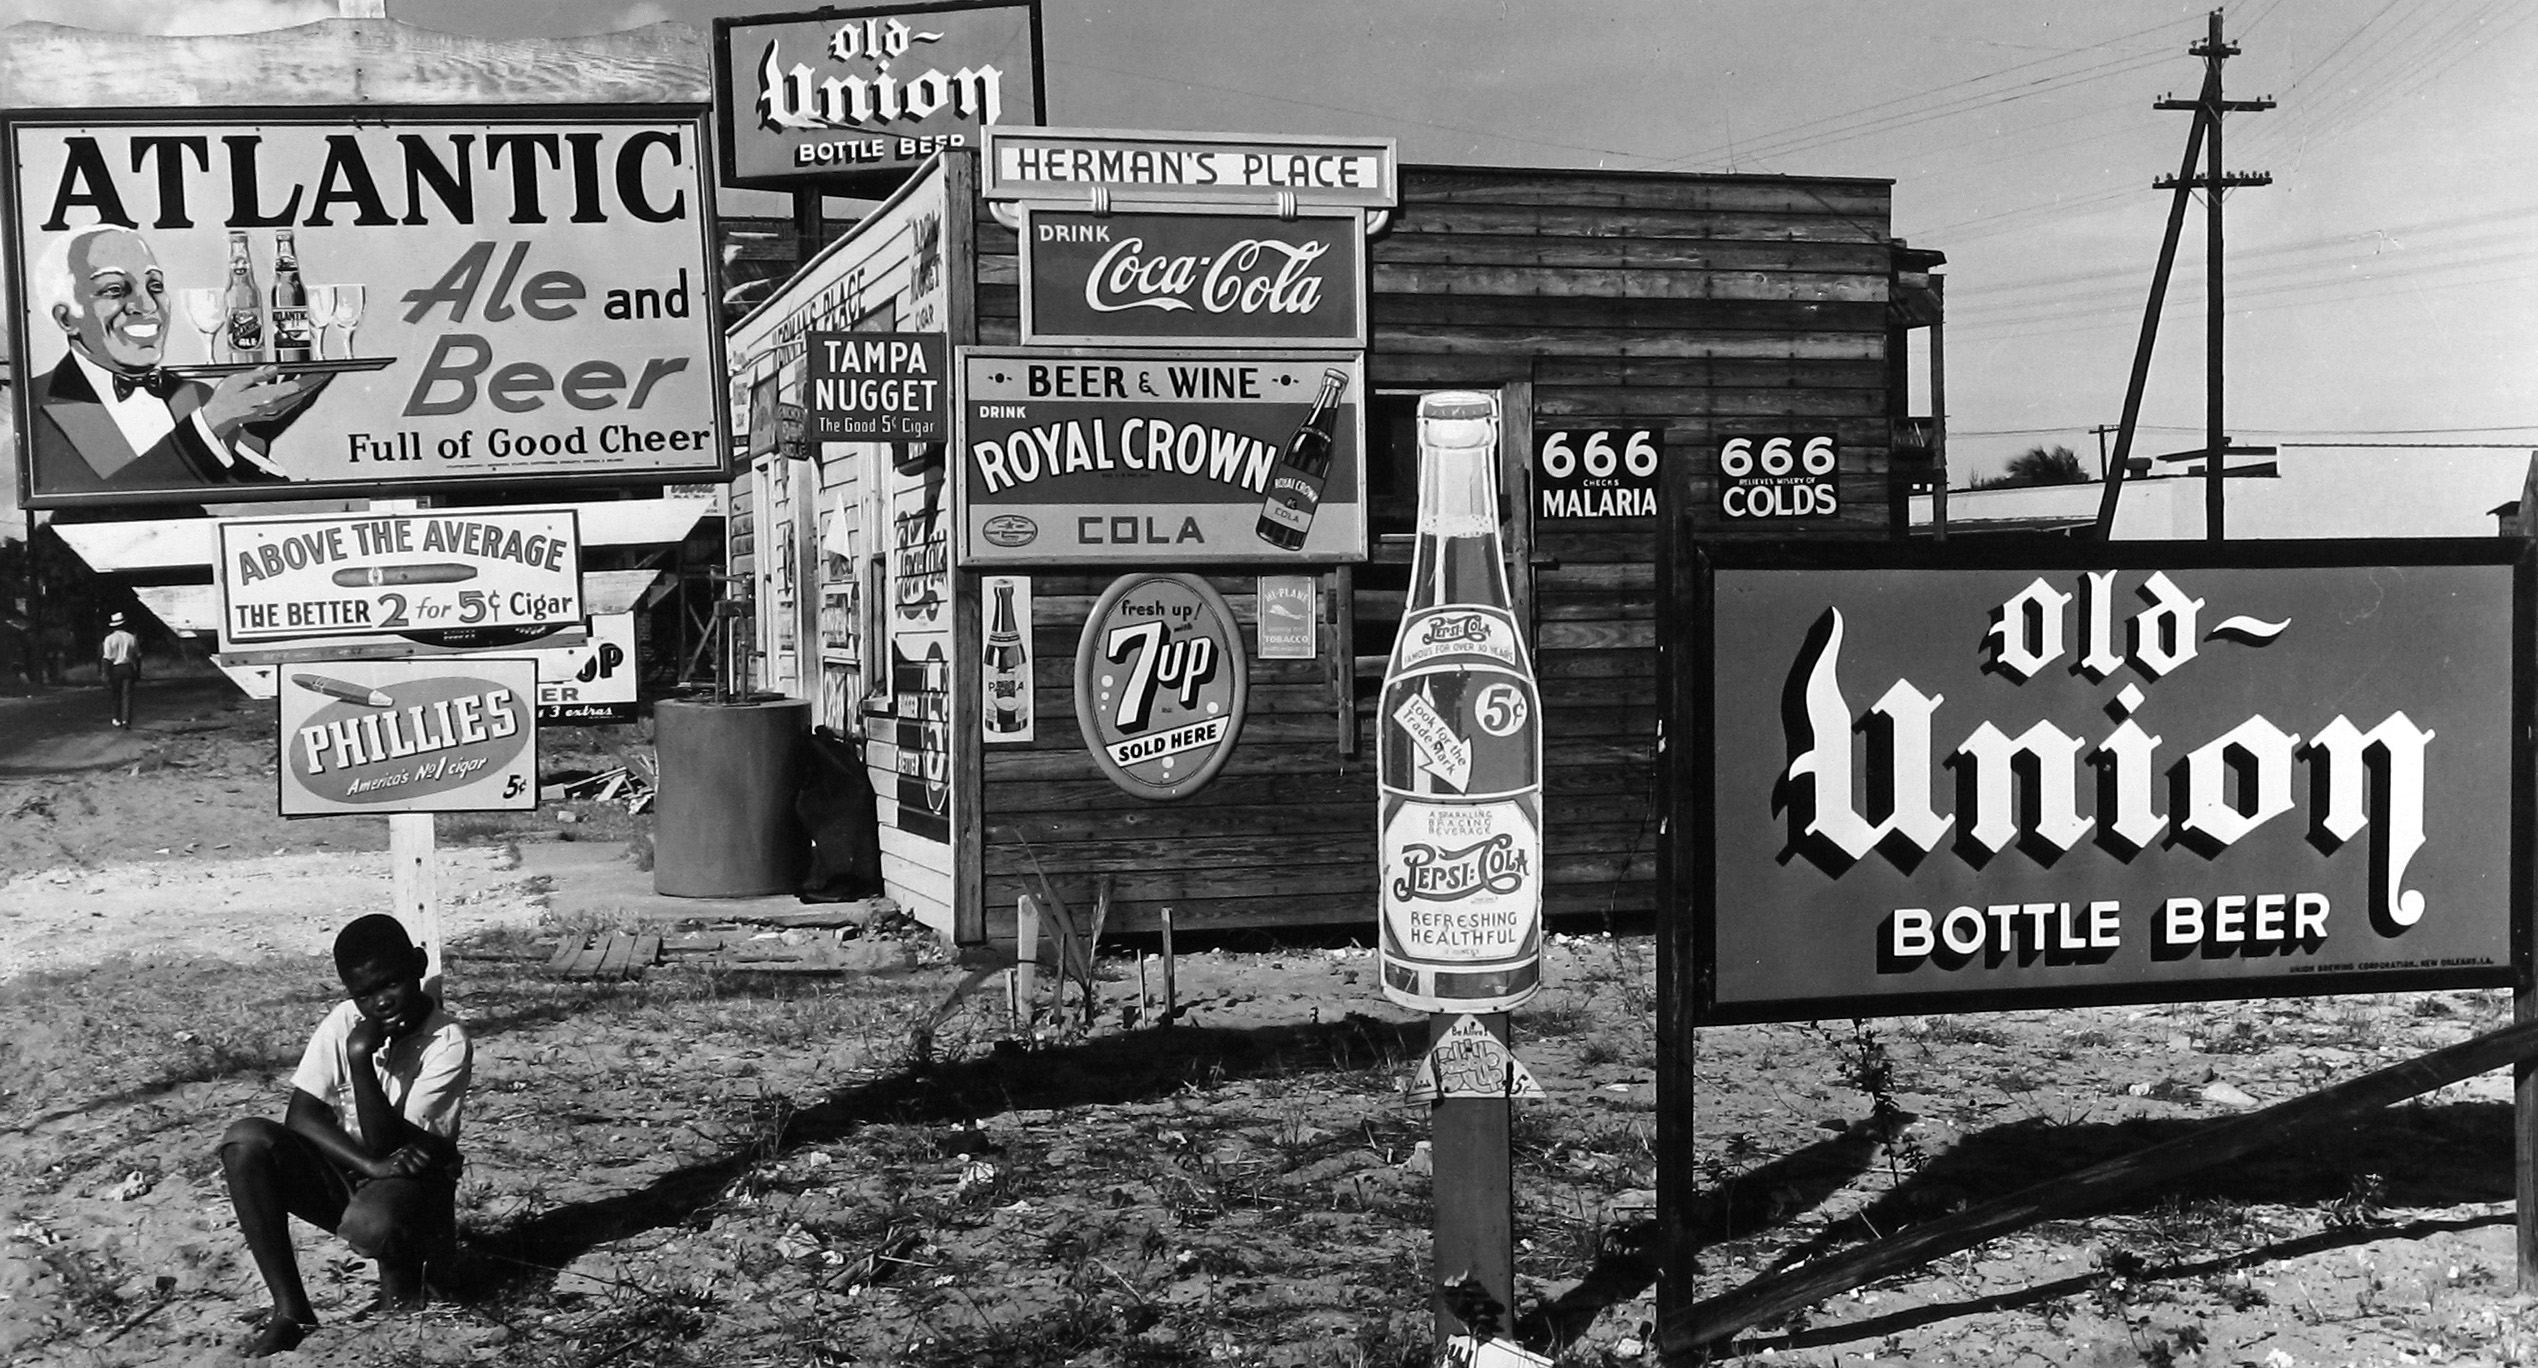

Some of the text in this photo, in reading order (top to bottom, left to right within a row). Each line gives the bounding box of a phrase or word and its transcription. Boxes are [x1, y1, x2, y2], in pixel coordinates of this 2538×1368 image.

[761, 39, 1002, 128] Union
[800, 139, 884, 162] BOTTLE
[40, 130, 686, 230] ATLANTIC
[1017, 149, 1360, 187] HERMAN'S PLACE
[1039, 225, 1110, 242] DRINK
[402, 241, 689, 322] Ale and
[1085, 237, 1330, 314] Coca-Cola
[824, 341, 927, 373] TAMPA
[403, 334, 689, 416] Beer
[1028, 365, 1260, 398] BEER & WINE
[816, 379, 937, 411] NUGGET
[820, 417, 840, 432] The
[845, 417, 876, 433] Good
[902, 417, 935, 437] Cigar
[979, 406, 1026, 418] DRINK
[348, 424, 710, 462] Full of Good Cheer
[972, 418, 1277, 494] ROYAL CROWN
[1542, 431, 1658, 478] 666
[1721, 436, 1836, 477] 666
[1583, 479, 1620, 487] CHECKS
[1274, 507, 1299, 523] COLA
[1543, 488, 1657, 518] MALARIA
[1723, 484, 1837, 517] COLDS
[1078, 516, 1205, 544] COLA
[239, 520, 567, 585] ABOVE THE AVERAGE
[236, 605, 279, 628] THE
[287, 600, 370, 625] BETTER
[377, 594, 409, 627] 2
[416, 596, 452, 619] for
[510, 592, 572, 621] Cigar
[1122, 600, 1164, 616] fresh
[1264, 635, 1308, 643] TOBACCO
[1405, 647, 1432, 662] FAMOUS
[1436, 644, 1450, 653] FOR
[1453, 643, 1474, 651] OVER
[1491, 646, 1513, 661] YEARS
[552, 706, 612, 717] 3 extras
[300, 689, 518, 774] PHILLIES
[1119, 724, 1216, 762] SOLD HERE
[1403, 710, 1455, 775] Trade Mark
[1410, 700, 1466, 766] Look for the
[347, 767, 408, 796] America's
[448, 756, 488, 778] cigar
[1789, 605, 2435, 926] Union
[1438, 810, 1492, 818] SPARKLING
[1411, 911, 1517, 928] REFRESHING
[1893, 892, 2330, 956] BOTTLE BEER
[1411, 929, 1516, 945] HEALTHFUL
[2318, 963, 2353, 972] BREWING
[2421, 959, 2437, 967] NEW
